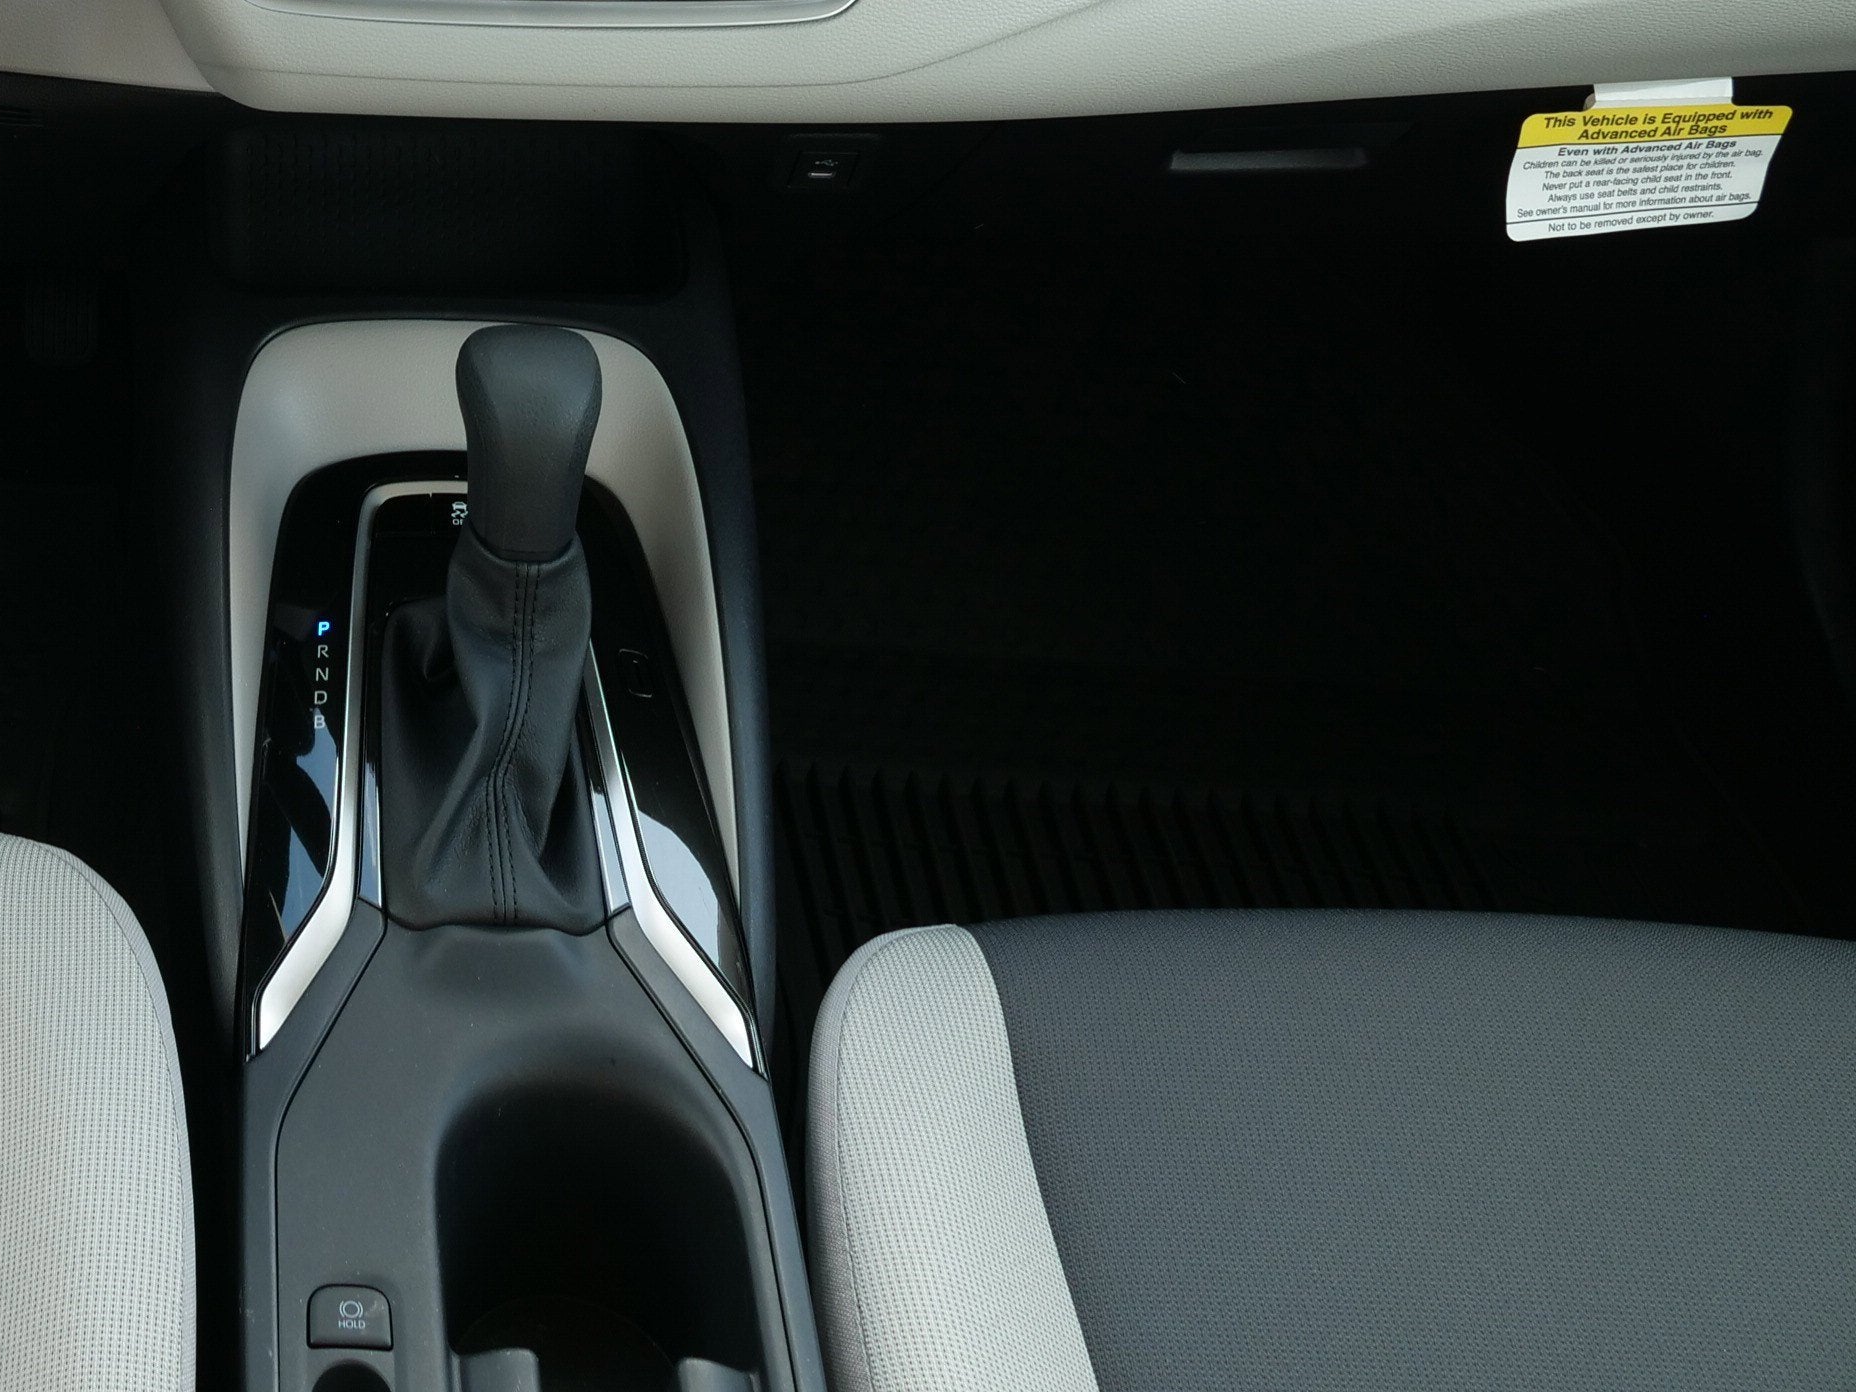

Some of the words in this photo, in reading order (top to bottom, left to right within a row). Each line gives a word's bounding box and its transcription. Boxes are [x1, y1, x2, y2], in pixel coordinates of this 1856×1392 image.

[1544, 116, 1576, 128] This
[1582, 114, 1638, 127] Vehicle
[1642, 113, 1656, 124] is
[1661, 110, 1737, 127] Equipped
[1740, 109, 1774, 120] with
[1578, 126, 1658, 140] Advanced
[1660, 125, 1685, 137] Air
[1688, 124, 1728, 137] Bags
[1558, 147, 1588, 156] Even
[1592, 146, 1618, 156] with
[1620, 142, 1682, 154] Advanced
[1684, 140, 1703, 150] Air
[1706, 140, 1737, 150] Bags
[1522, 160, 1559, 170] Children
[1560, 160, 1578, 168] can
[1580, 158, 1592, 166] be
[1593, 156, 1616, 166] killed
[1618, 156, 1628, 164] or
[1629, 154, 1668, 164] seriously
[1670, 152, 1701, 162] injured
[1702, 152, 1714, 160] by
[1715, 150, 1730, 158] the
[1731, 150, 1743, 158] air
[1744, 148, 1763, 158] bag.
[1544, 170, 1560, 179] The
[1562, 169, 1583, 178] back
[1585, 168, 1604, 176] seat
[1616, 166, 1630, 174] the
[1632, 164, 1658, 174] safest
[1659, 164, 1684, 173] place
[1686, 162, 1698, 170] for
[1700, 160, 1735, 169] children.
[1542, 182, 1568, 191] Never
[1569, 180, 1583, 190] put
[1592, 178, 1639, 187] rear-facing
[1640, 175, 1662, 184] child
[1664, 174, 1682, 182] seat
[1684, 173, 1692, 181] in
[1694, 172, 1708, 180] the
[1710, 170, 1732, 179] front.
[1548, 193, 1577, 204] Always
[1579, 192, 1595, 200] use
[1597, 190, 1615, 198] seat
[1617, 188, 1638, 196] belts
[1640, 186, 1657, 195] and
[1658, 186, 1678, 194] child
[1680, 182, 1722, 192] restraints.
[1517, 208, 1534, 218] See
[1536, 205, 1568, 216] owner's
[1570, 202, 1601, 213] manual
[1603, 202, 1614, 210] for
[1616, 200, 1637, 208] more
[1638, 196, 1686, 206] information
[1688, 194, 1714, 203] about
[1715, 193, 1727, 202] air
[1728, 192, 1752, 202] bags.
[1548, 223, 1565, 232] Not
[1567, 222, 1577, 231] to
[1580, 220, 1592, 230] be
[1594, 216, 1634, 228] removed
[1636, 214, 1666, 225] except
[1668, 212, 1680, 222] by
[1682, 210, 1714, 220] owner.
[318, 621, 330, 636] P
[318, 644, 329, 659] R
[316, 667, 329, 682] N
[314, 690, 328, 705] D
[314, 714, 325, 728] B
[338, 1319, 366, 1329] HOLD
